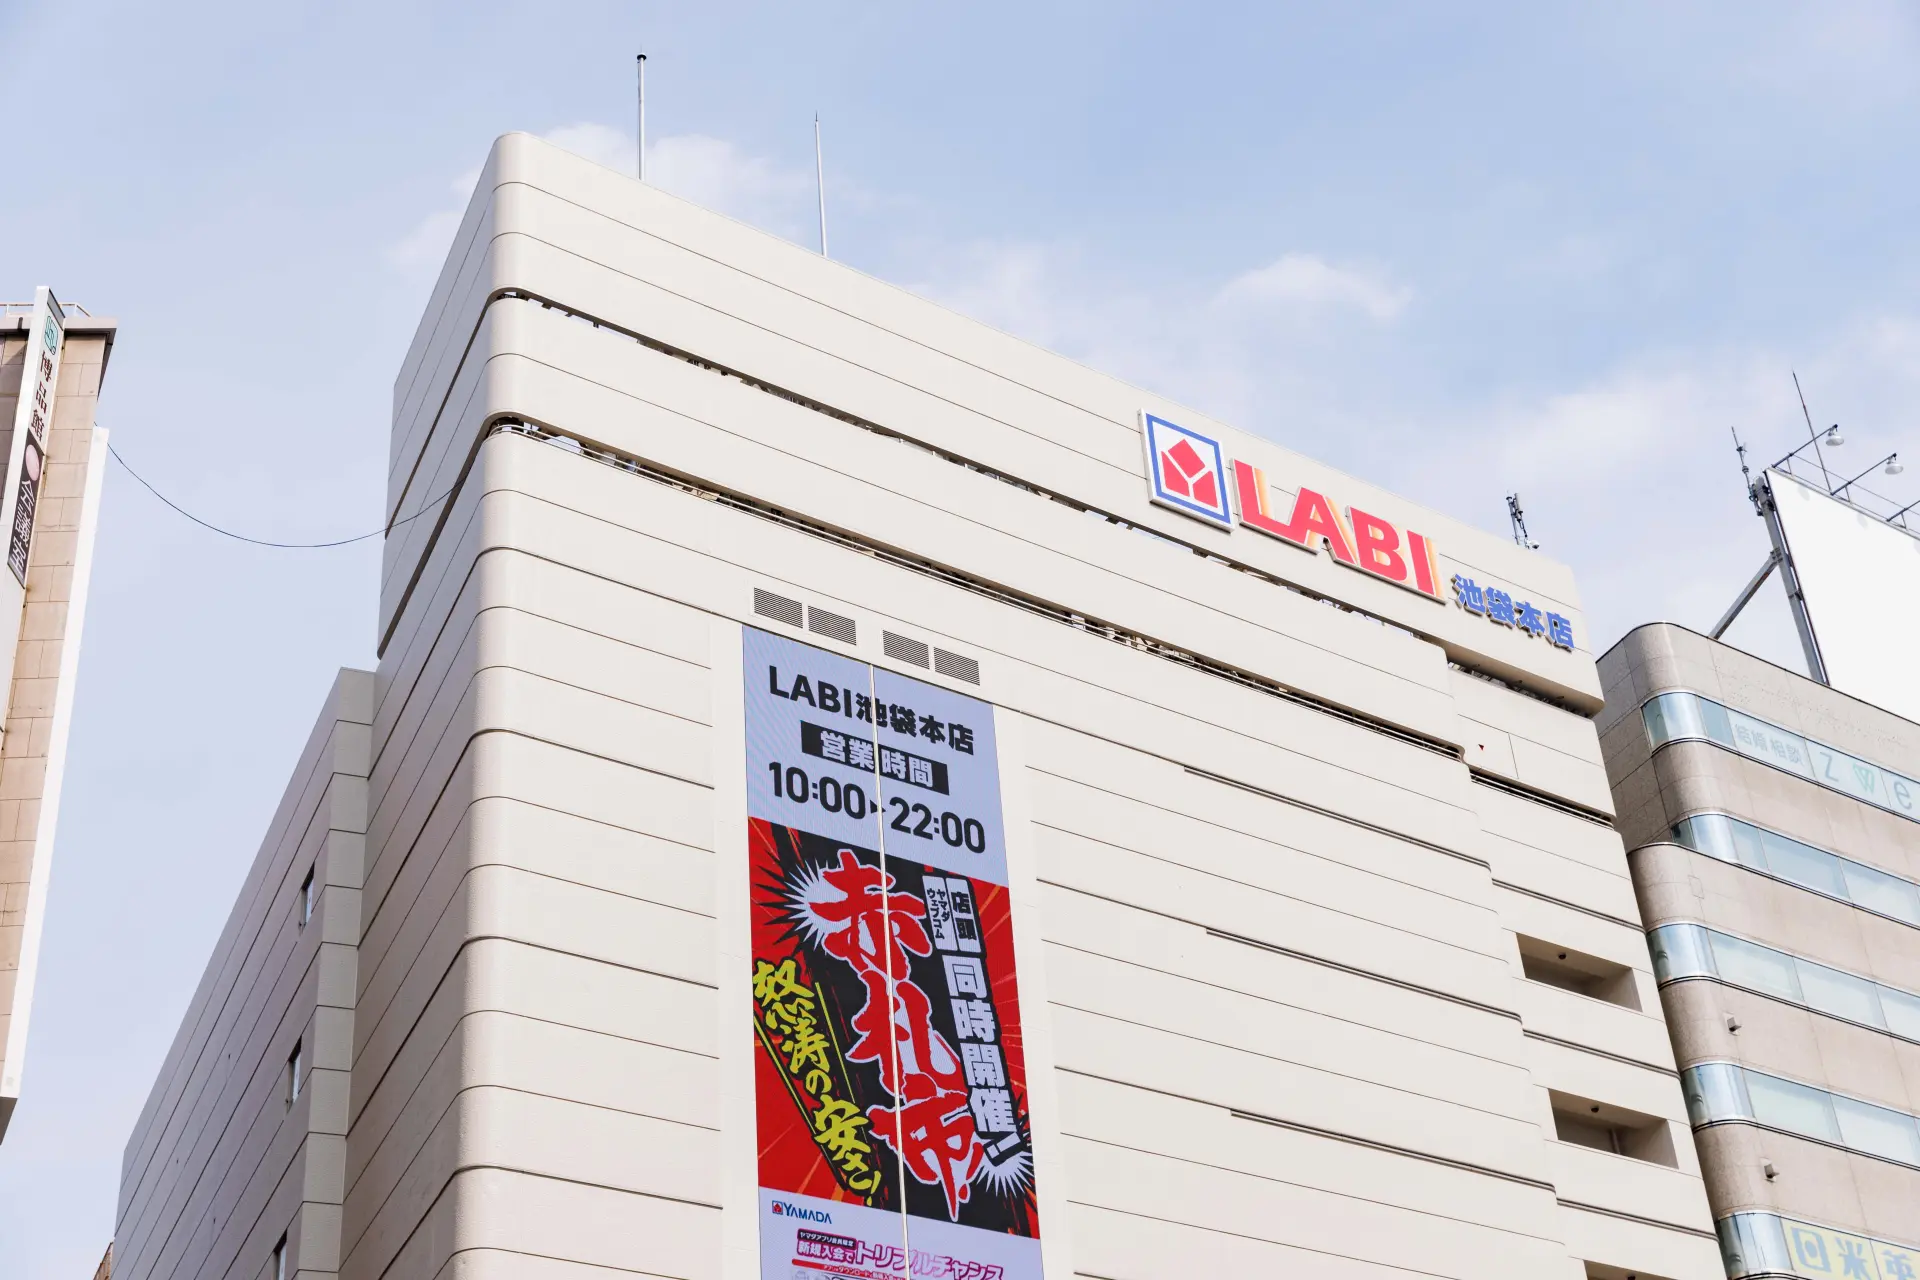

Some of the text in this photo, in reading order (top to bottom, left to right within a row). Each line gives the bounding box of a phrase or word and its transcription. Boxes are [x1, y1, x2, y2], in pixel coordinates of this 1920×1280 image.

[1233, 459, 1575, 651] LABI 池袋本店
[769, 665, 974, 755] LABI池袋本店
[820, 730, 933, 788] 営業時間
[769, 761, 986, 854] 10:00 22:00
[951, 892, 977, 940] 店頭
[943, 956, 1021, 1159] 同時開催!
[783, 1203, 832, 1224] YAMADA
